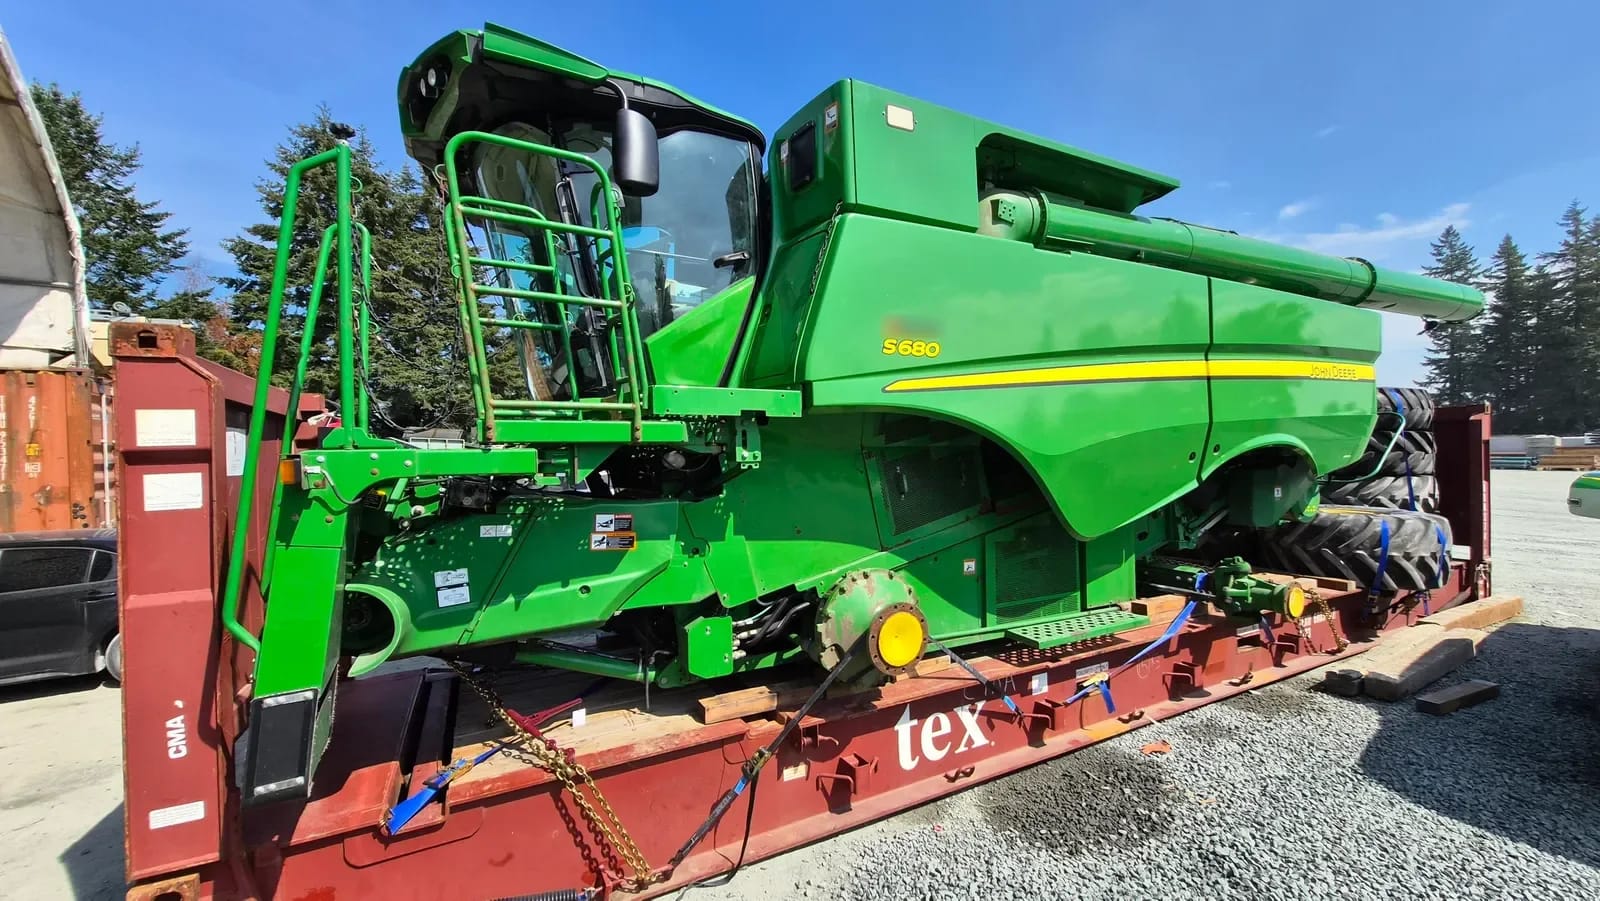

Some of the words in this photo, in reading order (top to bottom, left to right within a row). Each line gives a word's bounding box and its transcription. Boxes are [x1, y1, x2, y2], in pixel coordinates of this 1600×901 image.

[882, 338, 940, 358] S680
[1311, 364, 1331, 377] JOHN
[1332, 365, 1357, 379] DEERE
[165, 715, 187, 759] CMA
[894, 700, 990, 771] tex
